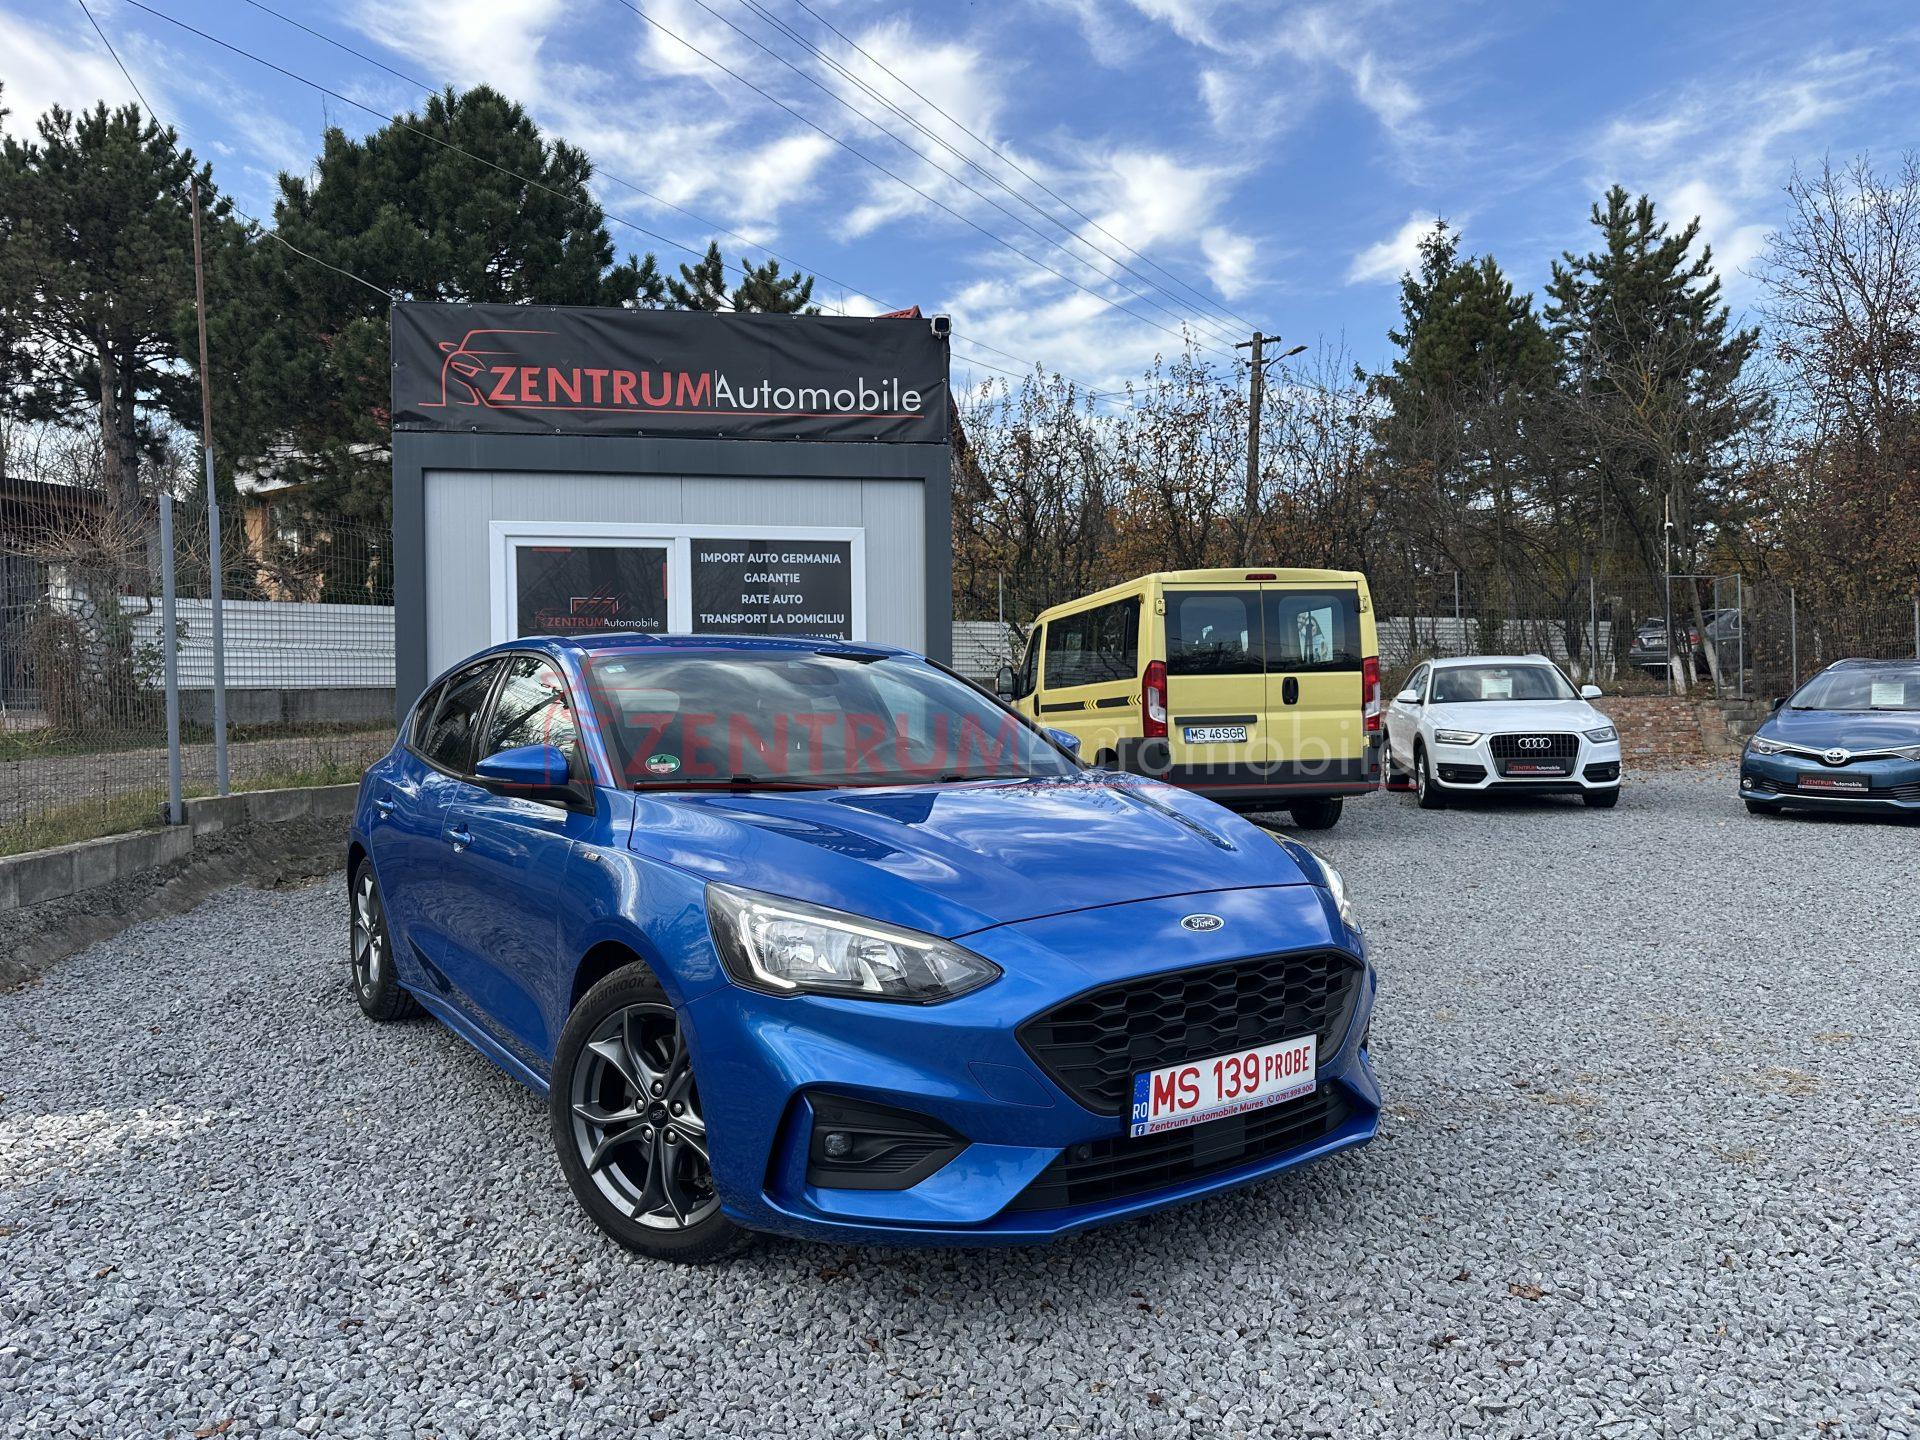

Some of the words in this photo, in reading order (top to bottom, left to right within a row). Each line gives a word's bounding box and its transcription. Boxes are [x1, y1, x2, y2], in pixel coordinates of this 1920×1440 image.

[487, 366, 711, 407] ZENTRUM
[715, 373, 922, 412] Automobile
[700, 552, 745, 563] IMPORT
[747, 553, 779, 563] AUTO
[781, 553, 842, 564] GERMANIA
[743, 572, 801, 586] GARANȚIE
[741, 594, 770, 604] RATE
[772, 594, 803, 604] AUTO
[547, 617, 604, 627] ZENTRUM
[603, 617, 659, 628] Automobile
[699, 613, 768, 624] TRANSPORT
[769, 613, 785, 624] LA
[786, 613, 845, 624] DOMICILIU
[1190, 728, 1206, 740] MS
[1152, 1067, 1201, 1117] MS
[1213, 1052, 1261, 1102] 139
[1265, 1045, 1311, 1082] PROBE
[1132, 1102, 1149, 1120] RO
[1149, 1116, 1189, 1133] Zentrum
[1189, 1104, 1239, 1124] Automobile
[1239, 1100, 1264, 1113] Mures
